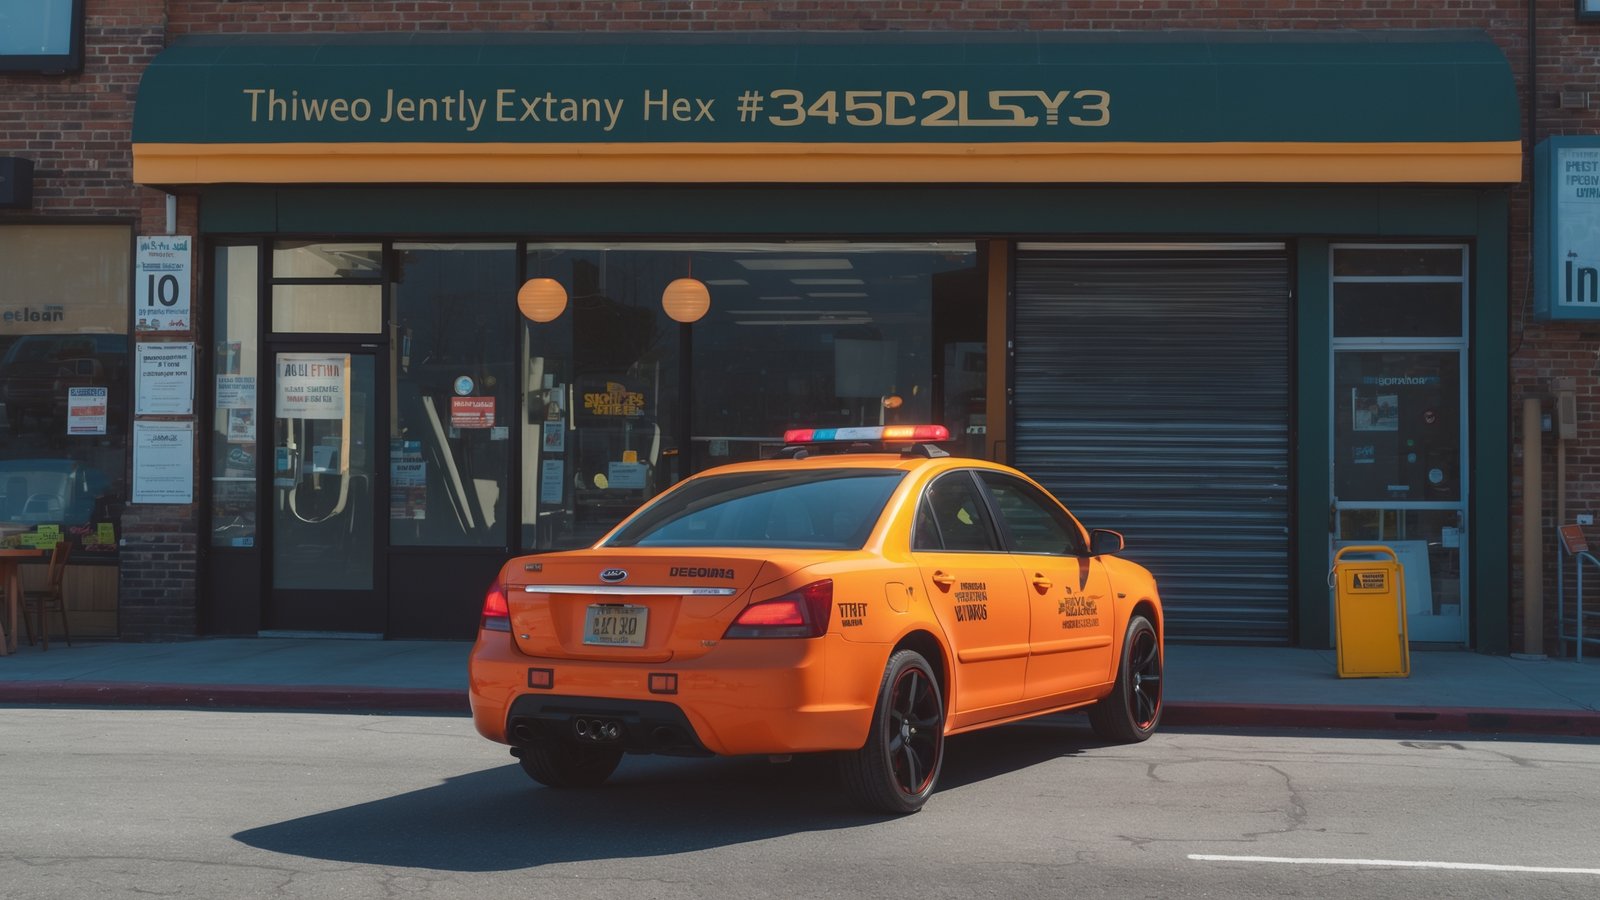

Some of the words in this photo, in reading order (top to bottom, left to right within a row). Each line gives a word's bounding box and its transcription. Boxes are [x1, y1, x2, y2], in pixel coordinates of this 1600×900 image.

[246, 88, 371, 122] Thiweo
[382, 88, 484, 131] Jently
[496, 88, 623, 131] Extany
[645, 89, 715, 120] Hex
[148, 274, 180, 308] 10
